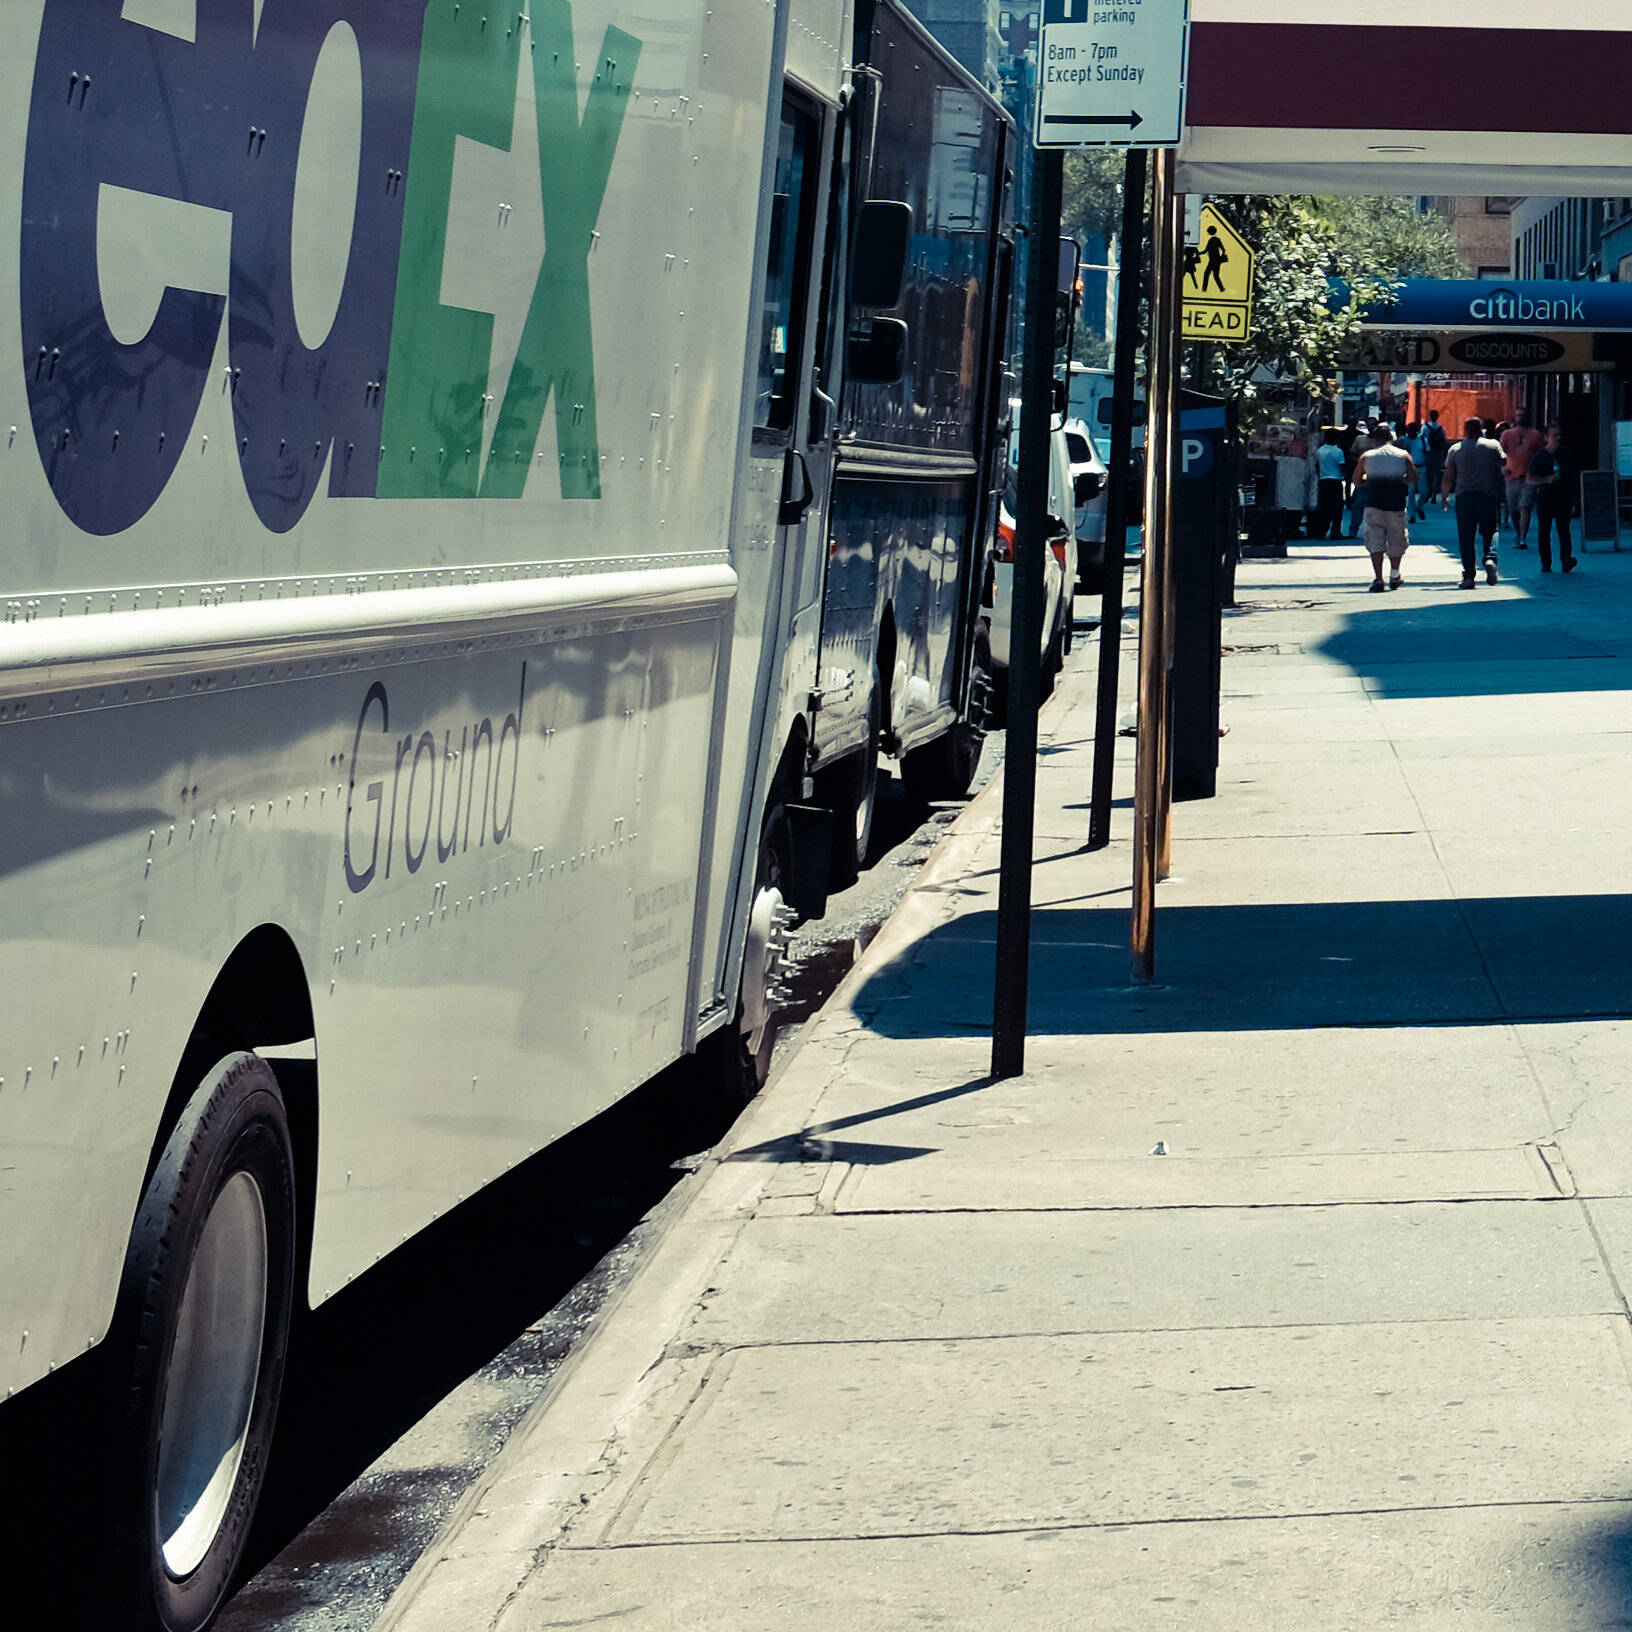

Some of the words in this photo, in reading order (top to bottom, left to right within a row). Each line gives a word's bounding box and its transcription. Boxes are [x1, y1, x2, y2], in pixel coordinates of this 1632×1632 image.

[1093, 8, 1136, 25] parking
[1048, 44, 1076, 61] 8am
[1091, 43, 1118, 63] 7pm
[1047, 65, 1092, 85] Except
[1096, 65, 1145, 85] Sunday
[1469, 292, 1585, 320] citibank
[1183, 310, 1241, 330] HEAD
[1465, 342, 1549, 359] DISCOUNTS
[343, 661, 527, 894] Ground
